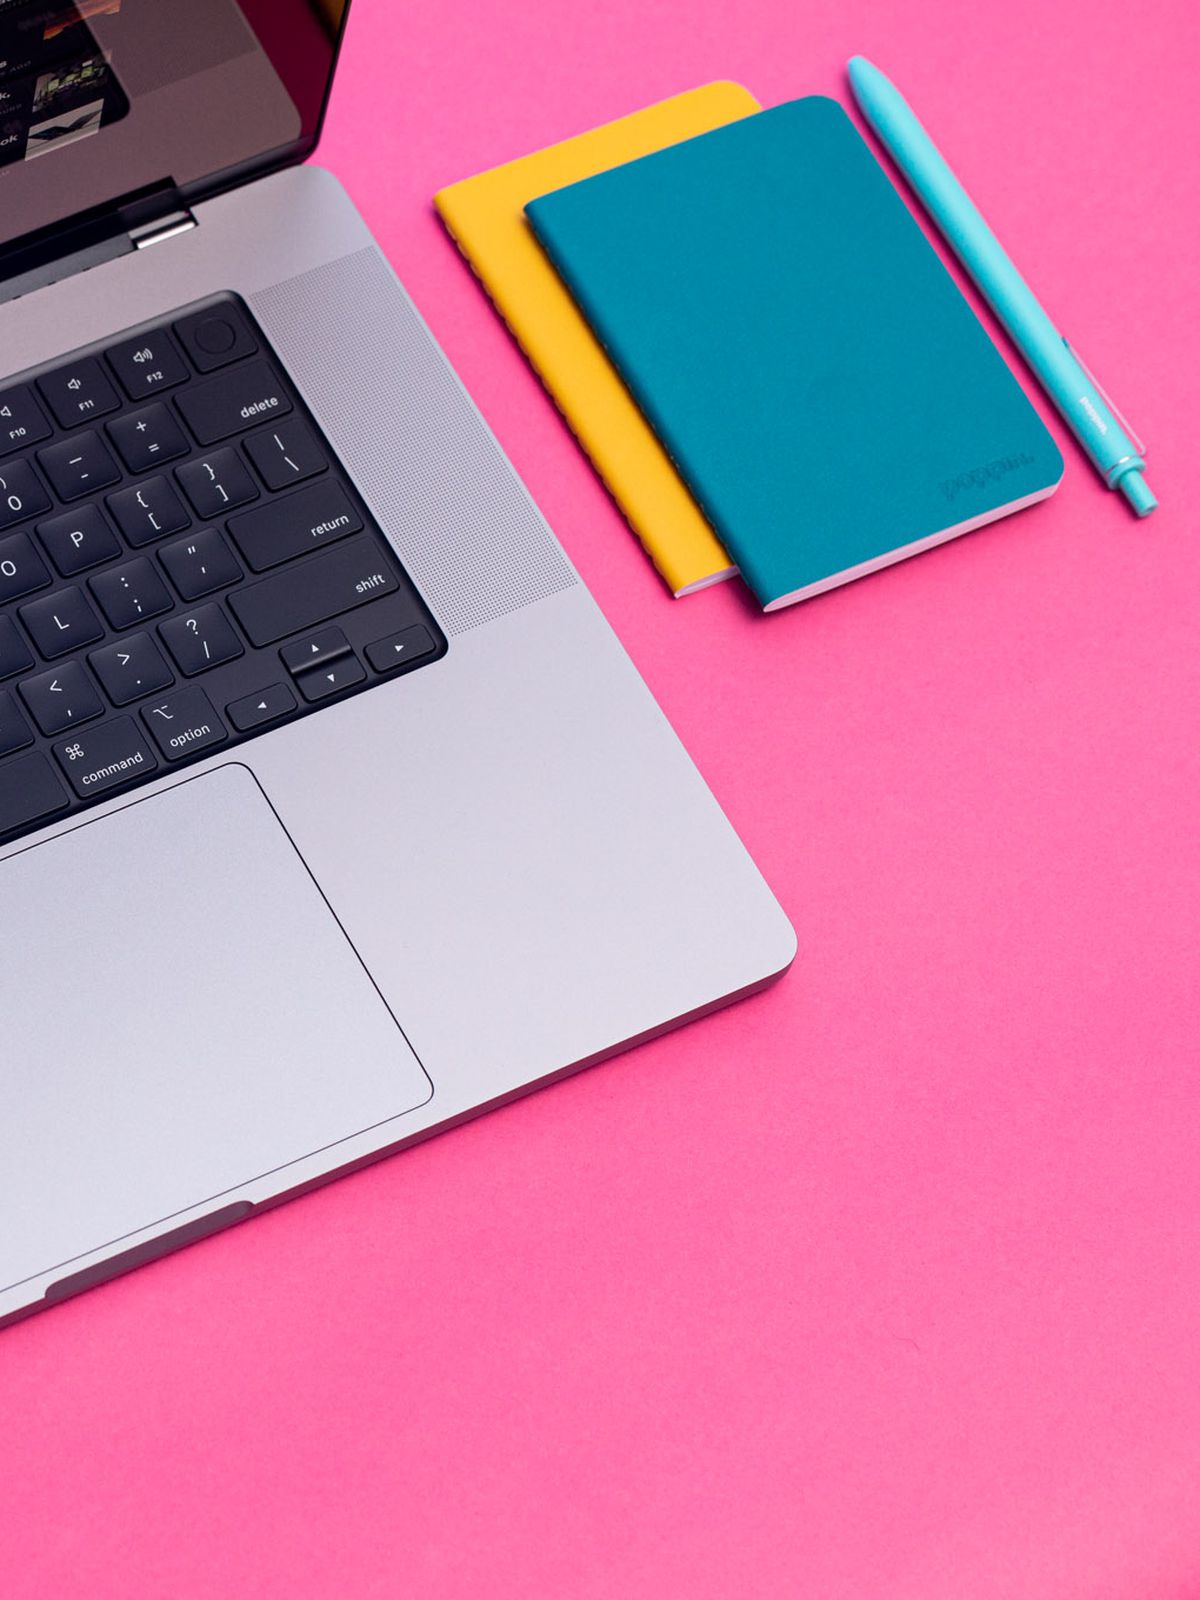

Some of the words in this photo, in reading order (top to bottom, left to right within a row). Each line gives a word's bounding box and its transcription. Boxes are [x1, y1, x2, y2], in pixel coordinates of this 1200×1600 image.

[146, 370, 164, 384] F12
[78, 399, 95, 412] F11
[240, 396, 279, 419] delete
[8, 426, 27, 440] F10
[135, 421, 147, 432] +
[7, 495, 23, 511] 0
[310, 515, 350, 537] return
[69, 530, 84, 549] P
[0, 560, 17, 577] O
[355, 573, 386, 593] shift
[53, 615, 70, 630] L
[186, 619, 199, 636] ?
[169, 723, 211, 748] option
[81, 751, 144, 786] command
